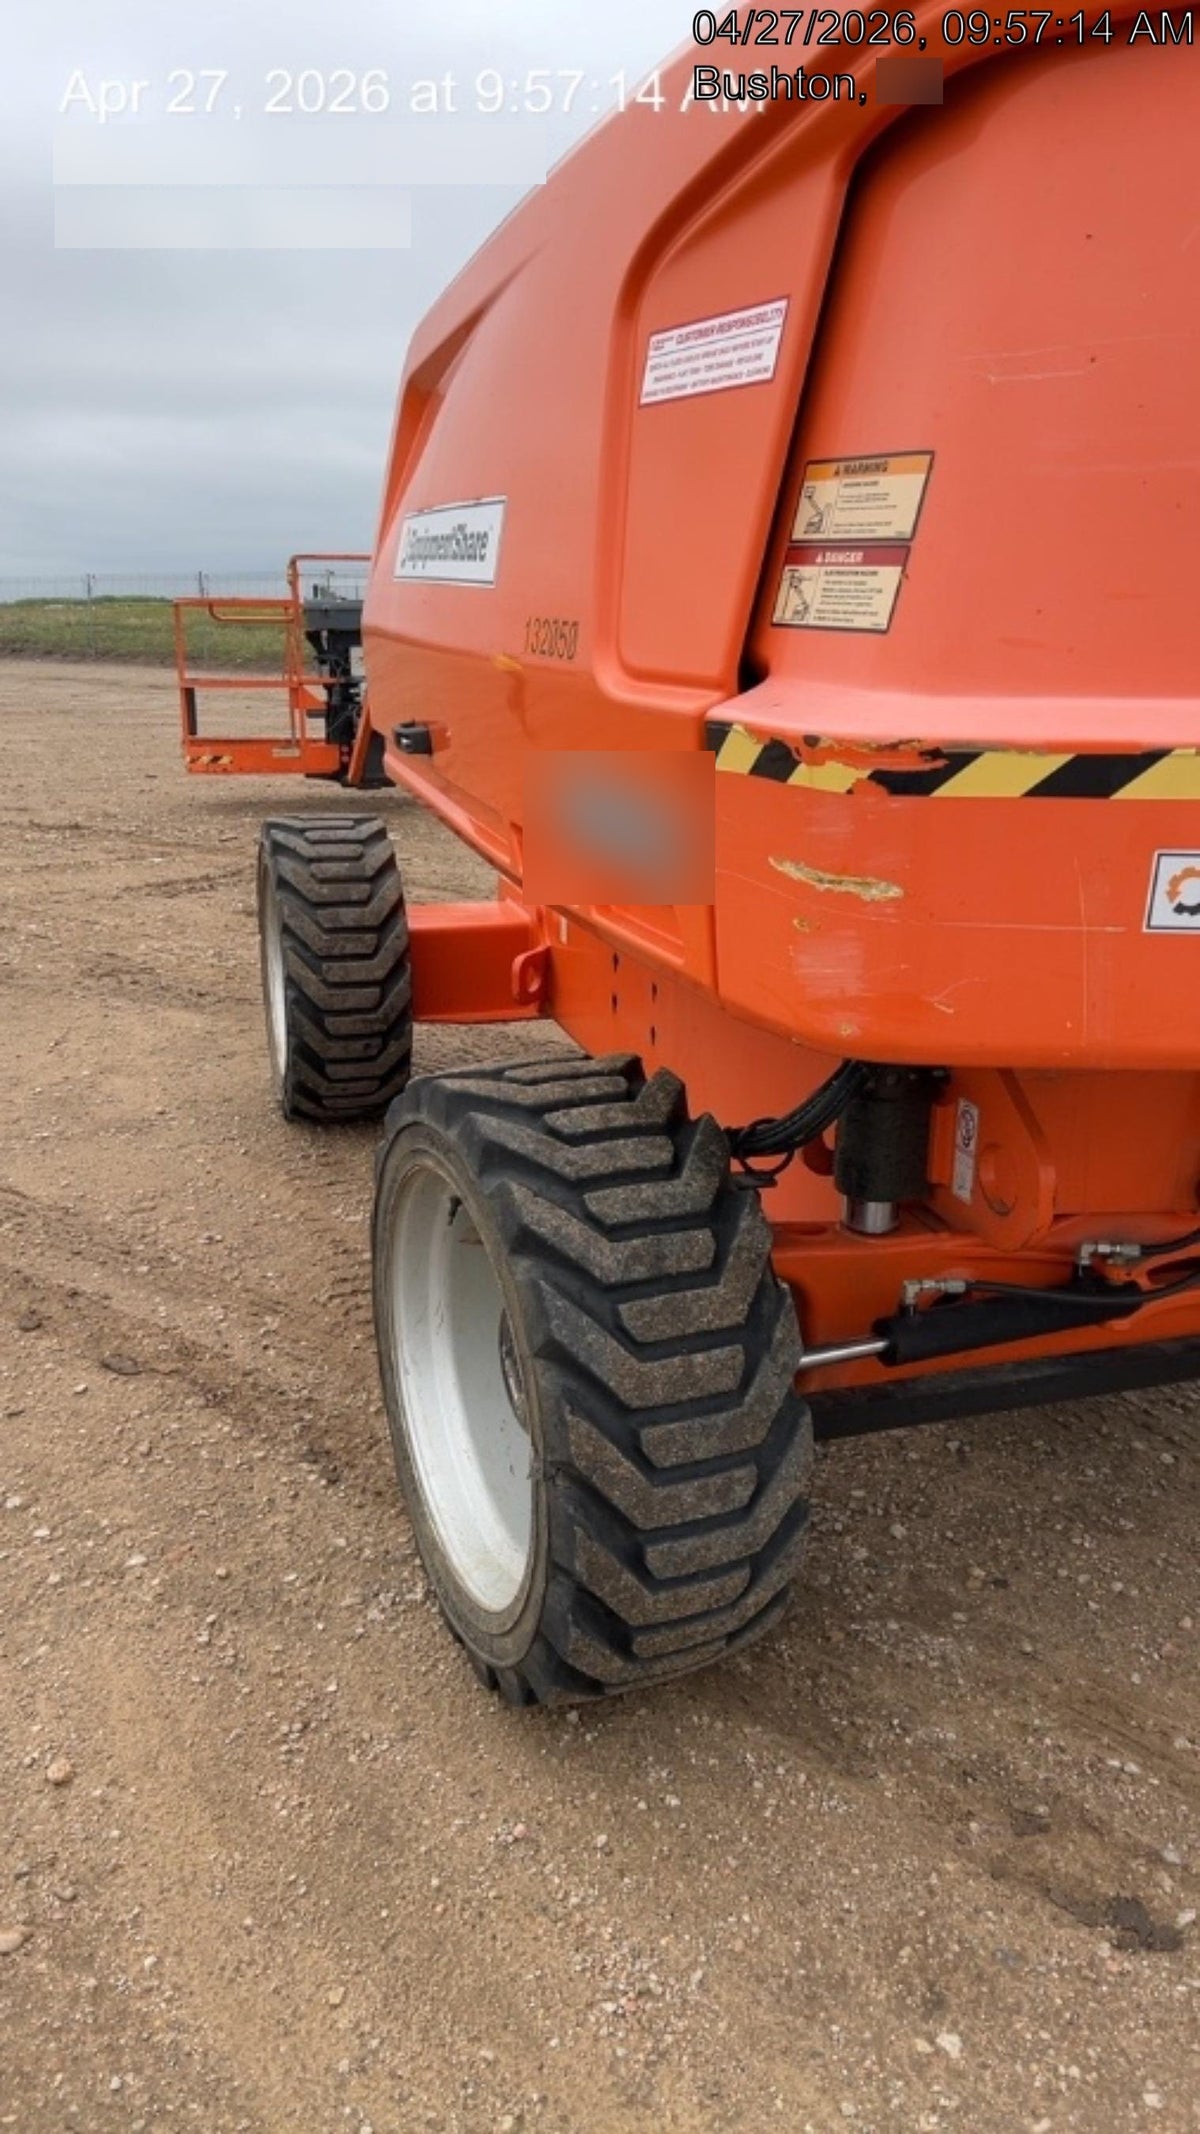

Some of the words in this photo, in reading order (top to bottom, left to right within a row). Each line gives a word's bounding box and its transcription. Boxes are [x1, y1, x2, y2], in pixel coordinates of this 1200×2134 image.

[843, 460, 889, 475] WARNING
[824, 551, 864, 564] DANGER
[524, 617, 579, 660] 132050
